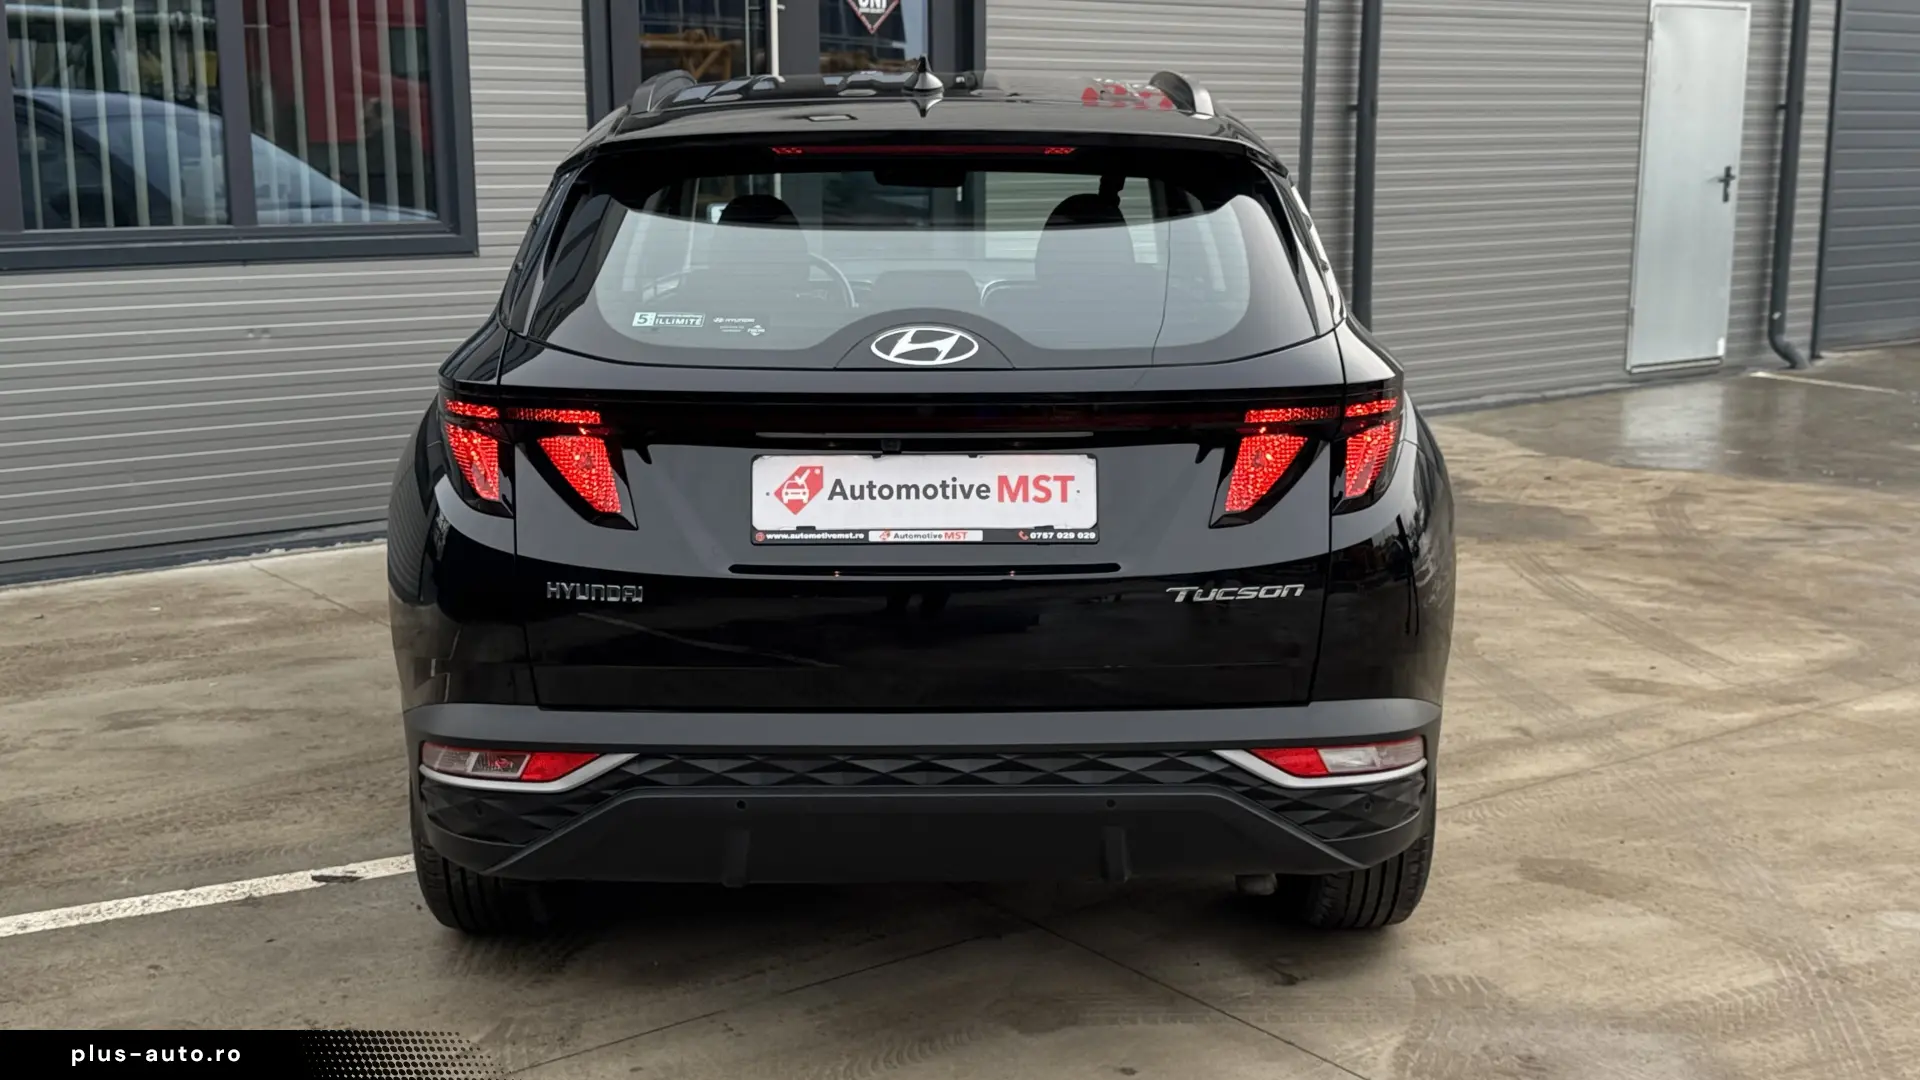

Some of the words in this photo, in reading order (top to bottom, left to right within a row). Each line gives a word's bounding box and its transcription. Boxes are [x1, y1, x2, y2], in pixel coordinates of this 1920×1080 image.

[827, 477, 991, 500] Automotive
[997, 475, 1075, 503] MST
[766, 531, 864, 540] www.automotivemst.ro
[893, 531, 943, 540] Automotive
[944, 531, 968, 540] MST
[1029, 531, 1055, 540] 0757
[1056, 531, 1076, 540] 029
[546, 581, 643, 603] HYUNDAI
[1165, 583, 1305, 603] TUCSON
